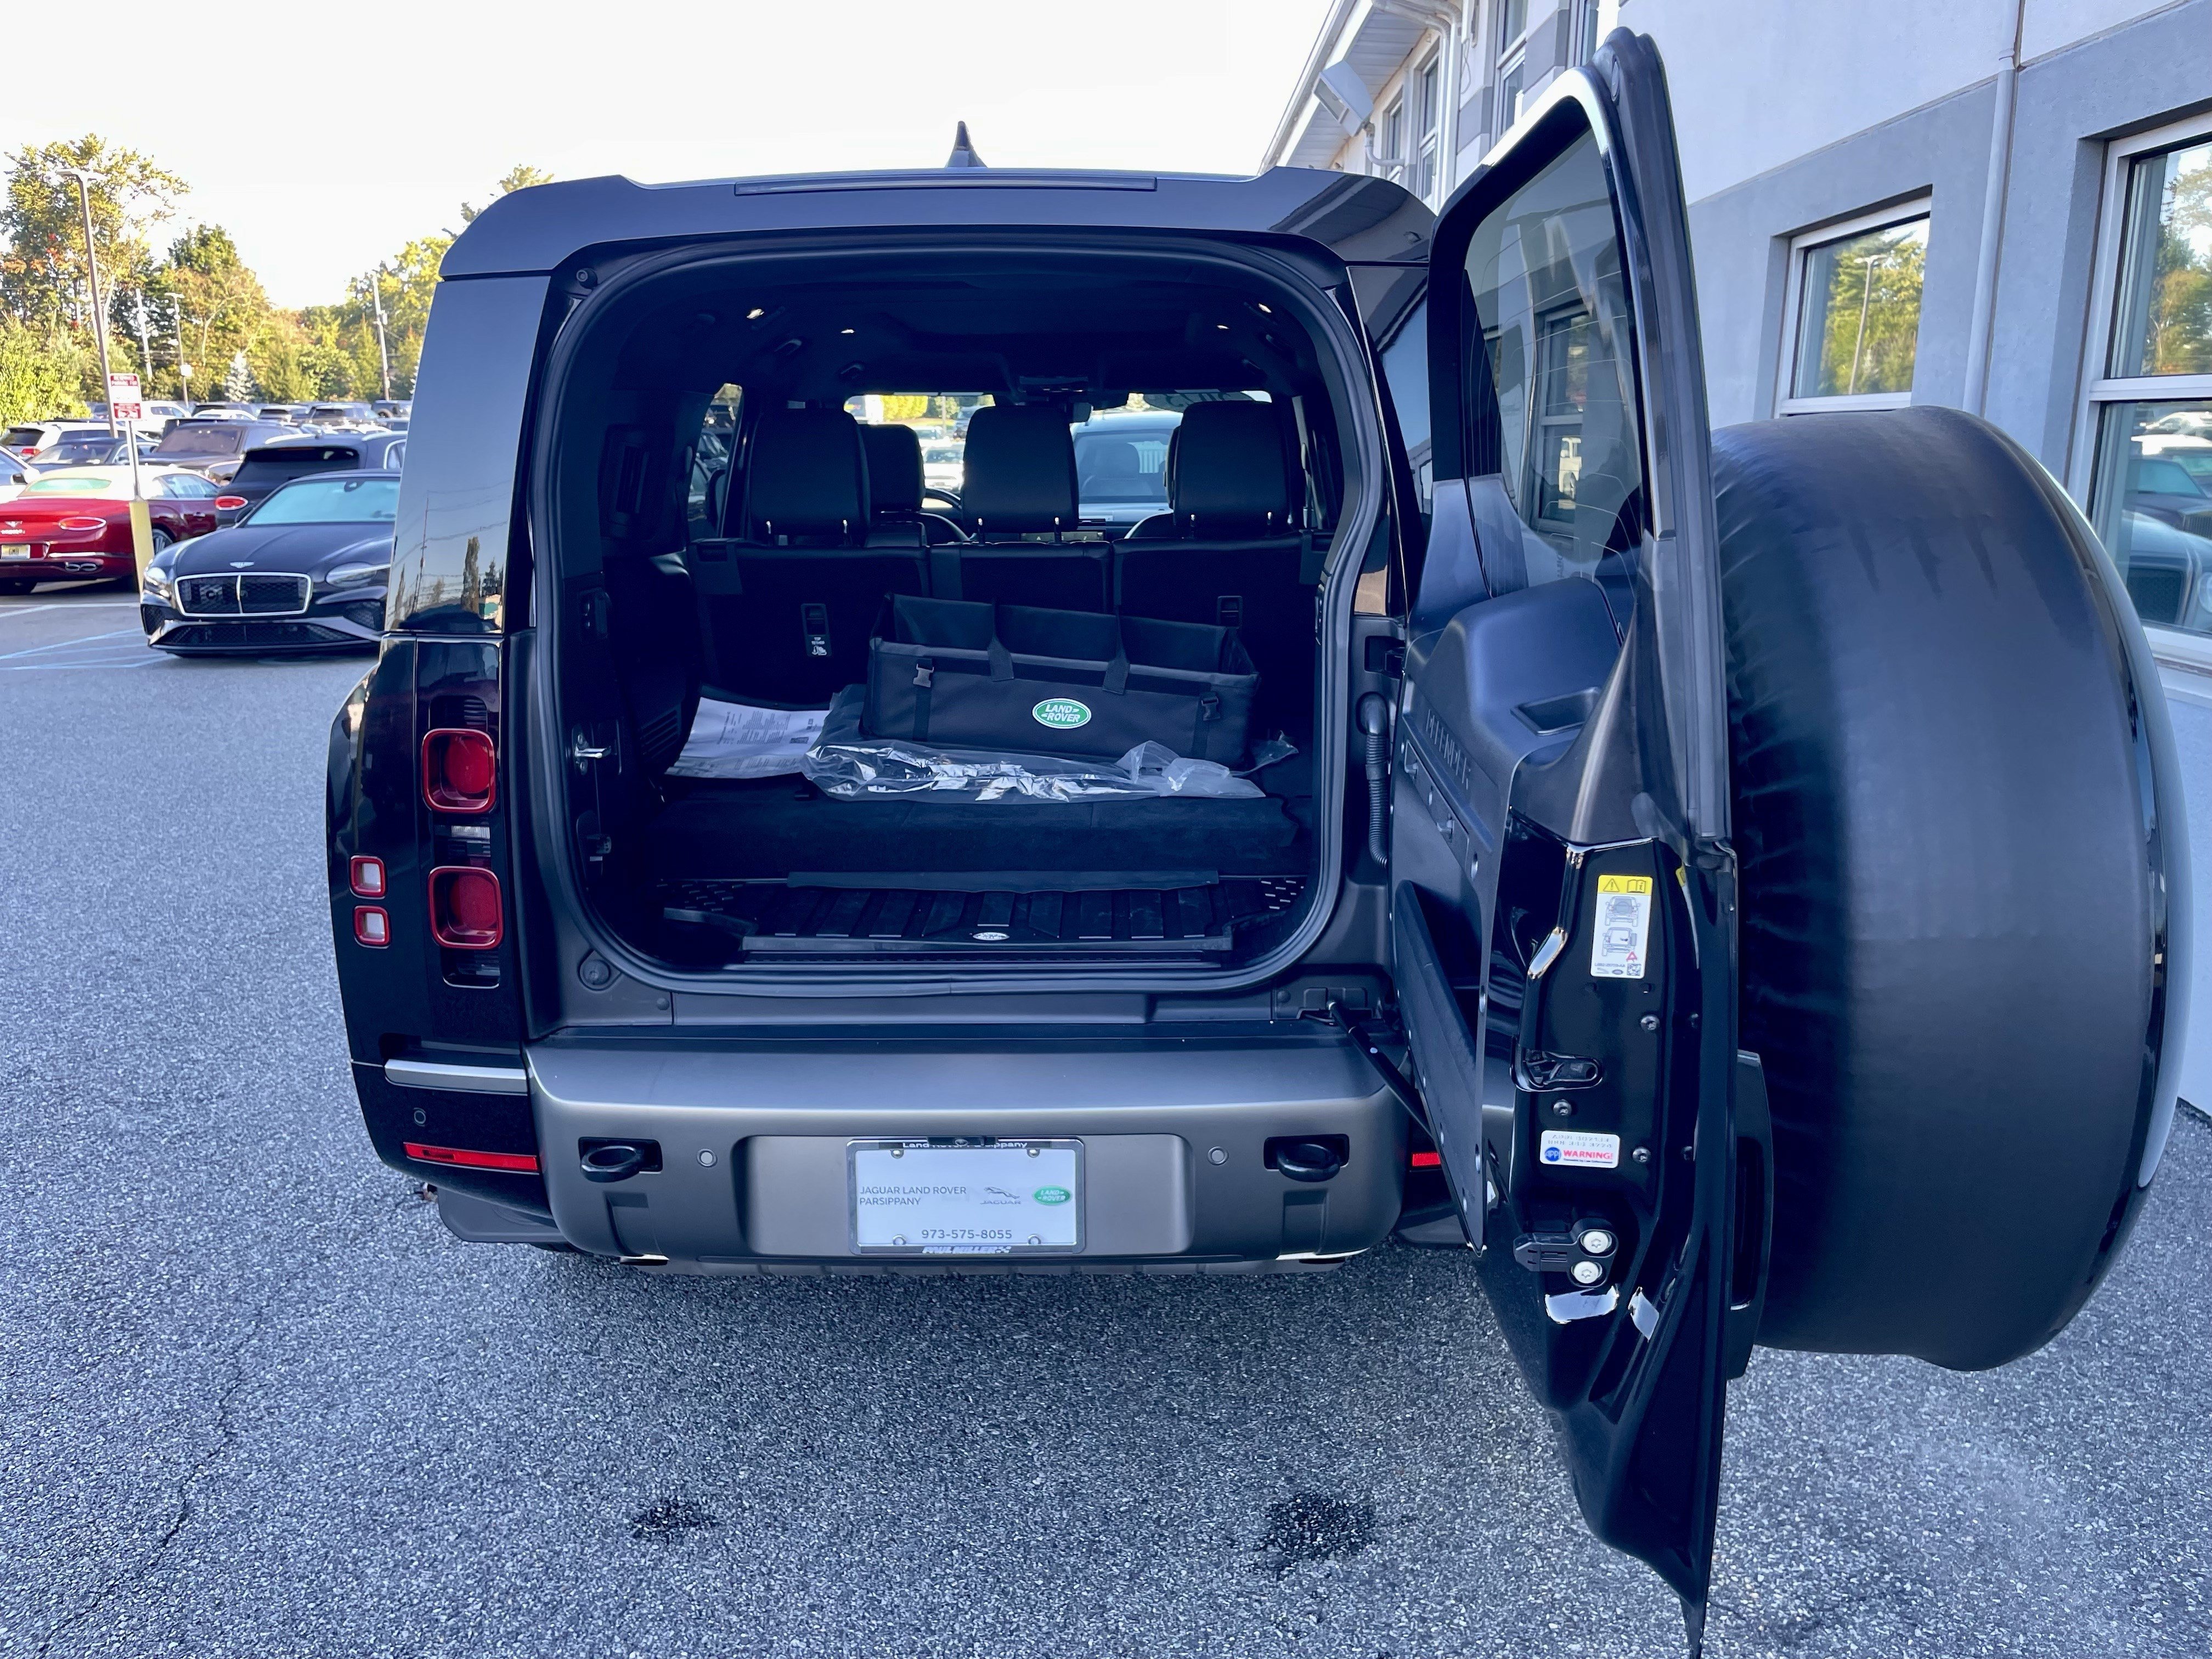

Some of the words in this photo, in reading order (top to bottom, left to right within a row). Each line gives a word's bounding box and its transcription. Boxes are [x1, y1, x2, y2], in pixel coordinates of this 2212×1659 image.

[1045, 704, 1073, 713] LAND
[1047, 713, 1081, 723] ROVER
[1564, 1150, 1613, 1160] WARNING!
[860, 1186, 900, 1194] JAGUAR
[903, 1186, 930, 1194] LAND
[933, 1186, 967, 1194] ROVER
[860, 1197, 921, 1205] PARSIPPANY
[921, 1229, 1012, 1239] 973-575-8055
